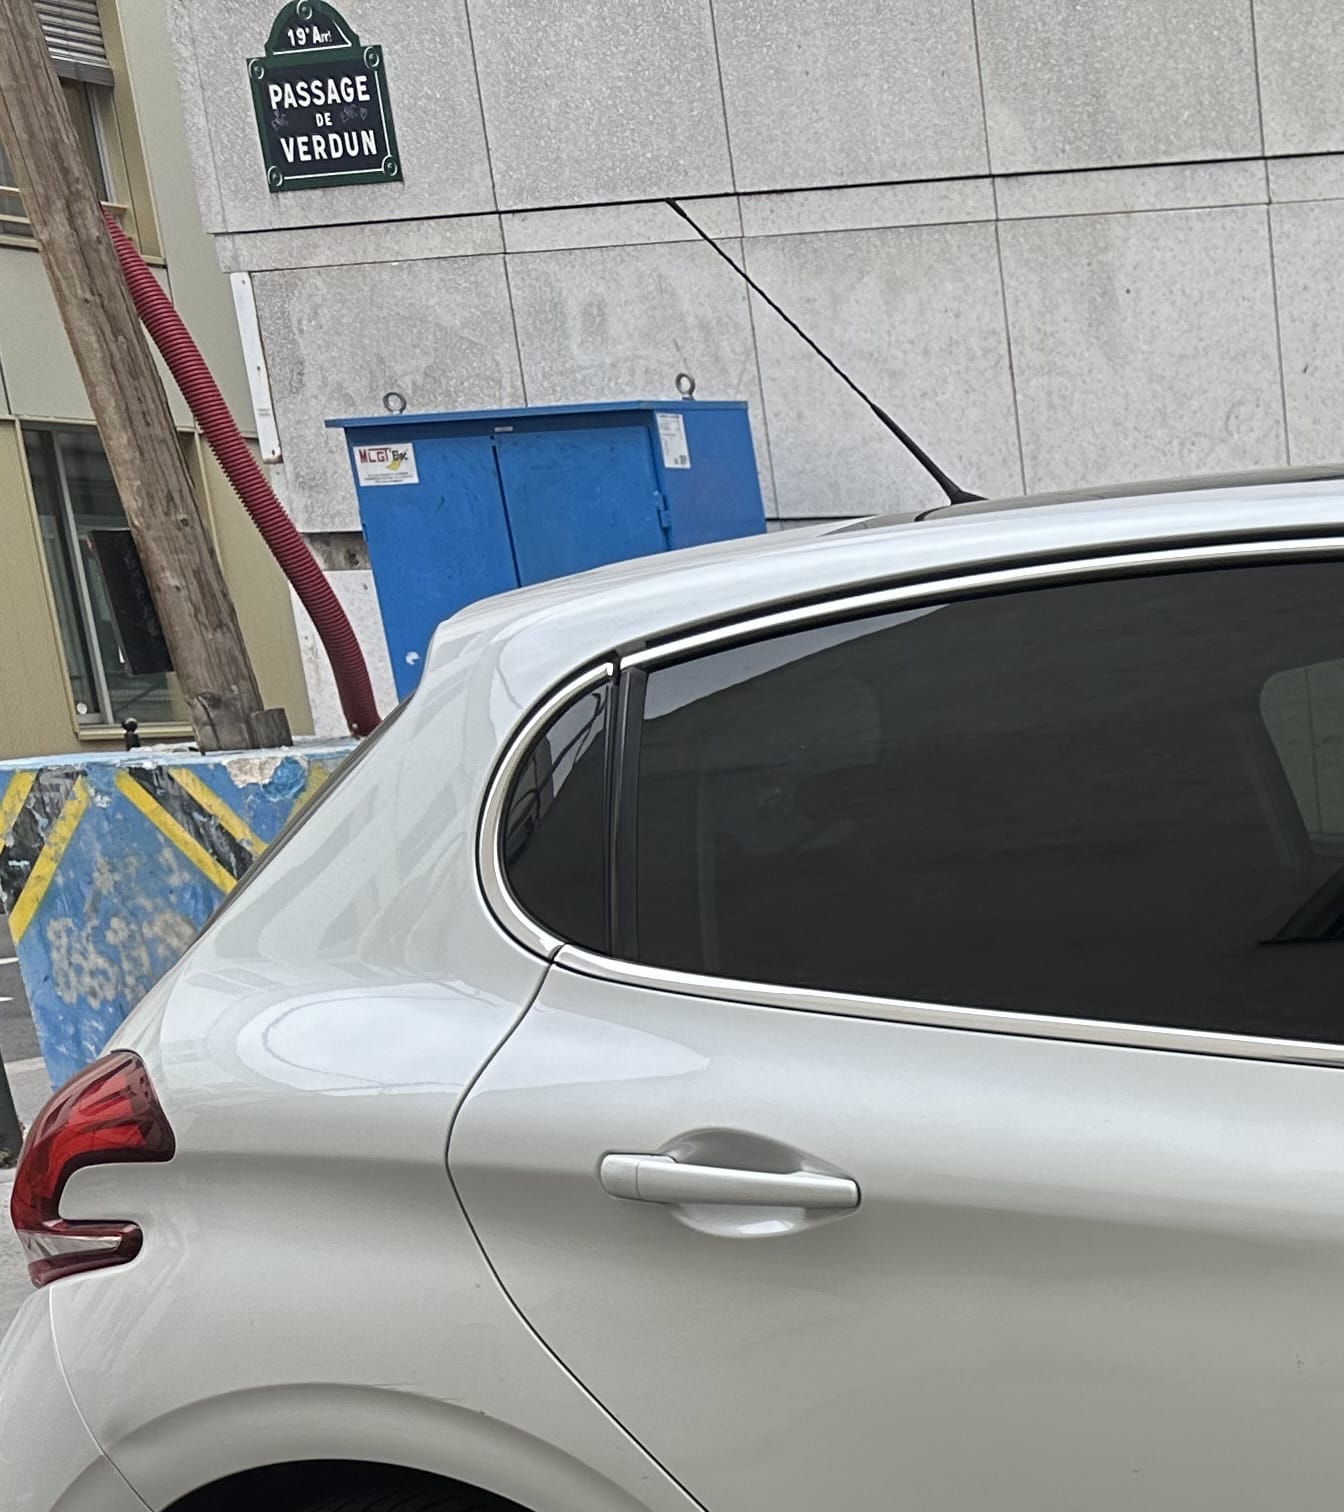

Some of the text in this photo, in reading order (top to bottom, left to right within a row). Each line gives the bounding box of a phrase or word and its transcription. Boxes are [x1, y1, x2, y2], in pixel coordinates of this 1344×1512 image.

[268, 75, 370, 110] PASSAGE
[315, 112, 333, 127] DE
[280, 129, 378, 163] VERDUN
